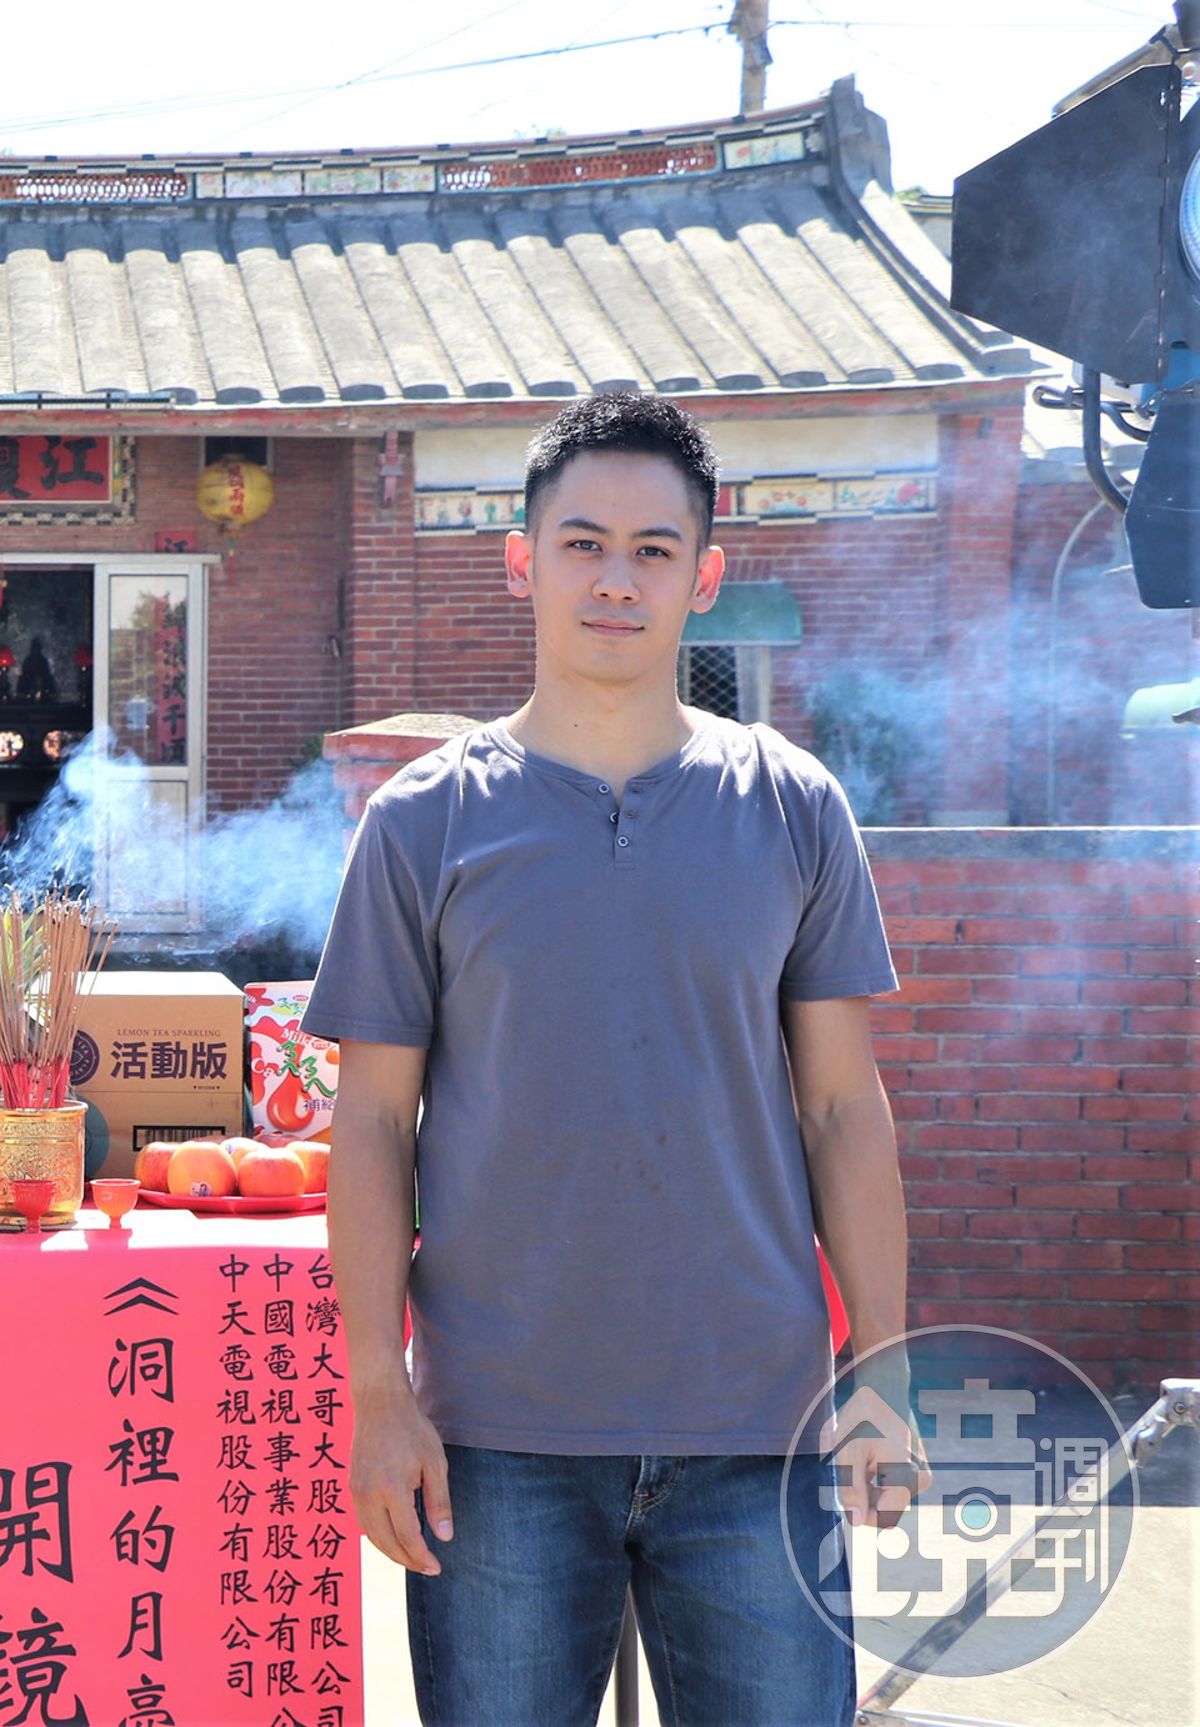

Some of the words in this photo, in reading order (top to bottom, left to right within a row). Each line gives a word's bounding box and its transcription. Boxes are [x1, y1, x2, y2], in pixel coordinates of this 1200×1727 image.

[118, 1029, 149, 1037] LEMON
[153, 1029, 169, 1037] TEA
[172, 1029, 221, 1037] SPARKLING
[110, 1041, 227, 1080] 活動版
[216, 1253, 260, 1698] 中天電視股份有限公司
